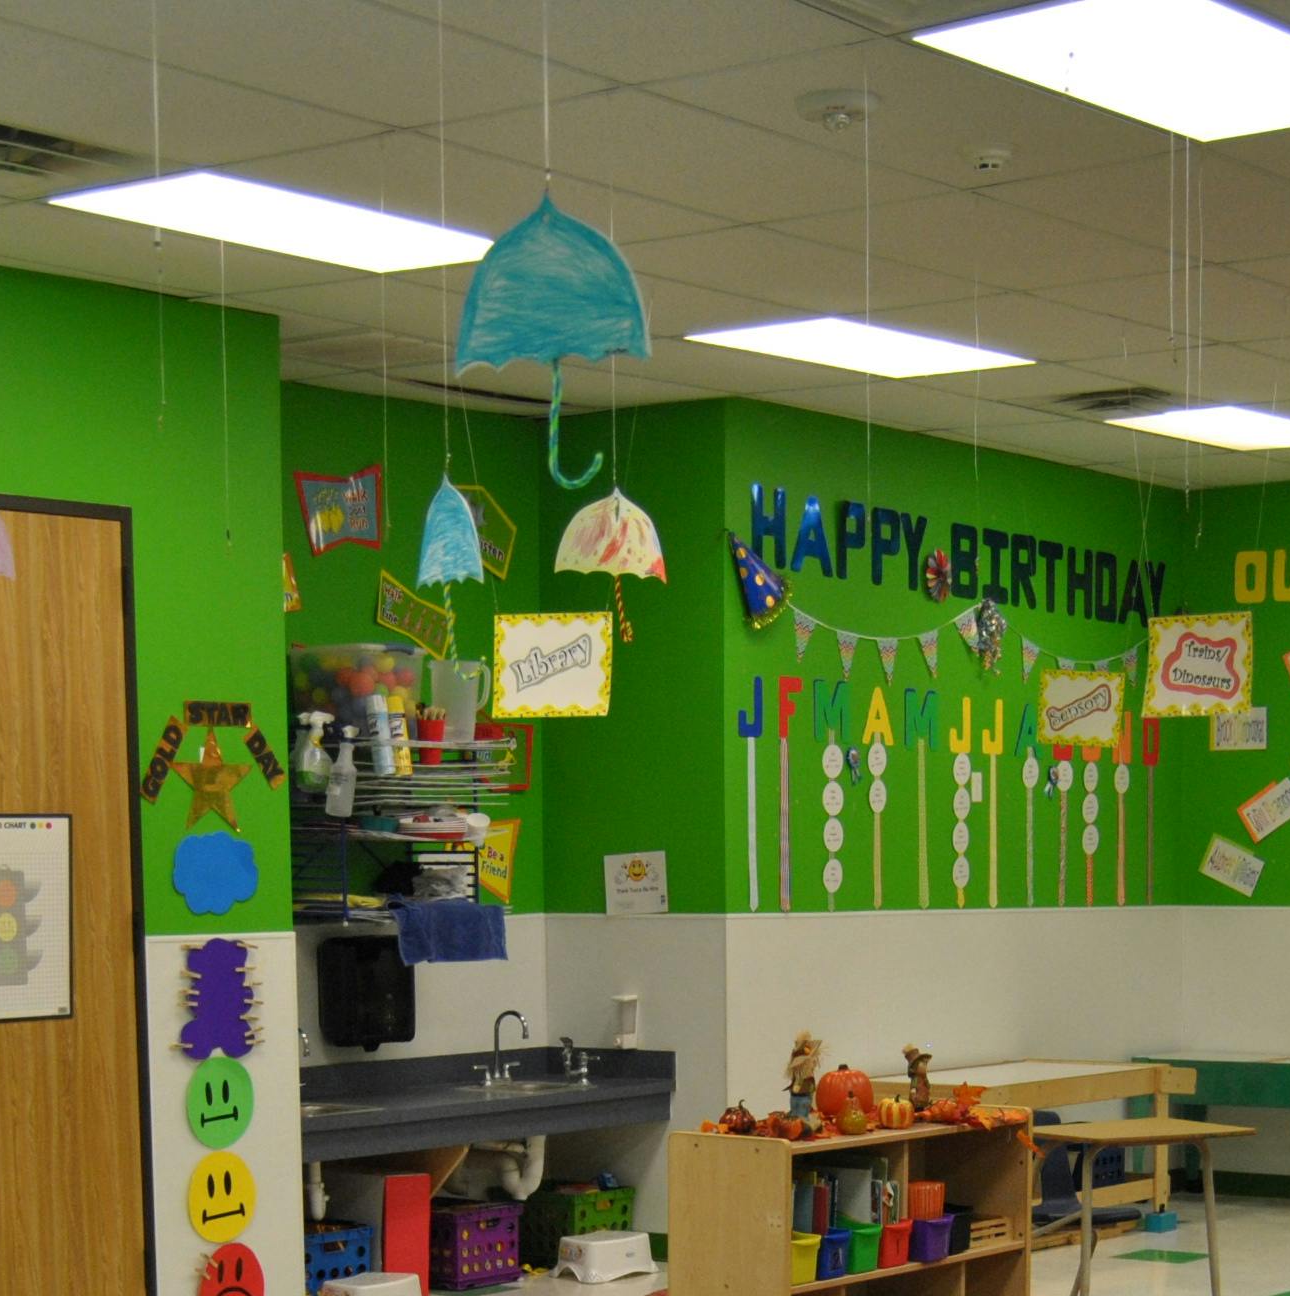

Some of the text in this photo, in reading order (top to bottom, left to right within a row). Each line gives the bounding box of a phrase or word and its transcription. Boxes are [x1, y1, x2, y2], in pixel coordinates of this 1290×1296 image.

[479, 537, 506, 561] isten
[750, 481, 1166, 628] HAPPY BIRTHDAY
[517, 637, 593, 690] Library
[1184, 639, 1229, 664] Trains/
[1172, 667, 1232, 691] Dinosaurs
[188, 702, 250, 727] STAR
[738, 676, 762, 738] J
[778, 676, 802, 738] F
[813, 679, 850, 743] M
[862, 686, 893, 746] A
[904, 688, 938, 752] M
[949, 696, 971, 754] J
[982, 698, 1003, 755] J
[1049, 689, 1108, 727] Sensory
[142, 725, 183, 798] GOLD
[246, 729, 285, 780] DAY
[486, 846, 498, 860] Be
[480, 860, 508, 880] Friend
